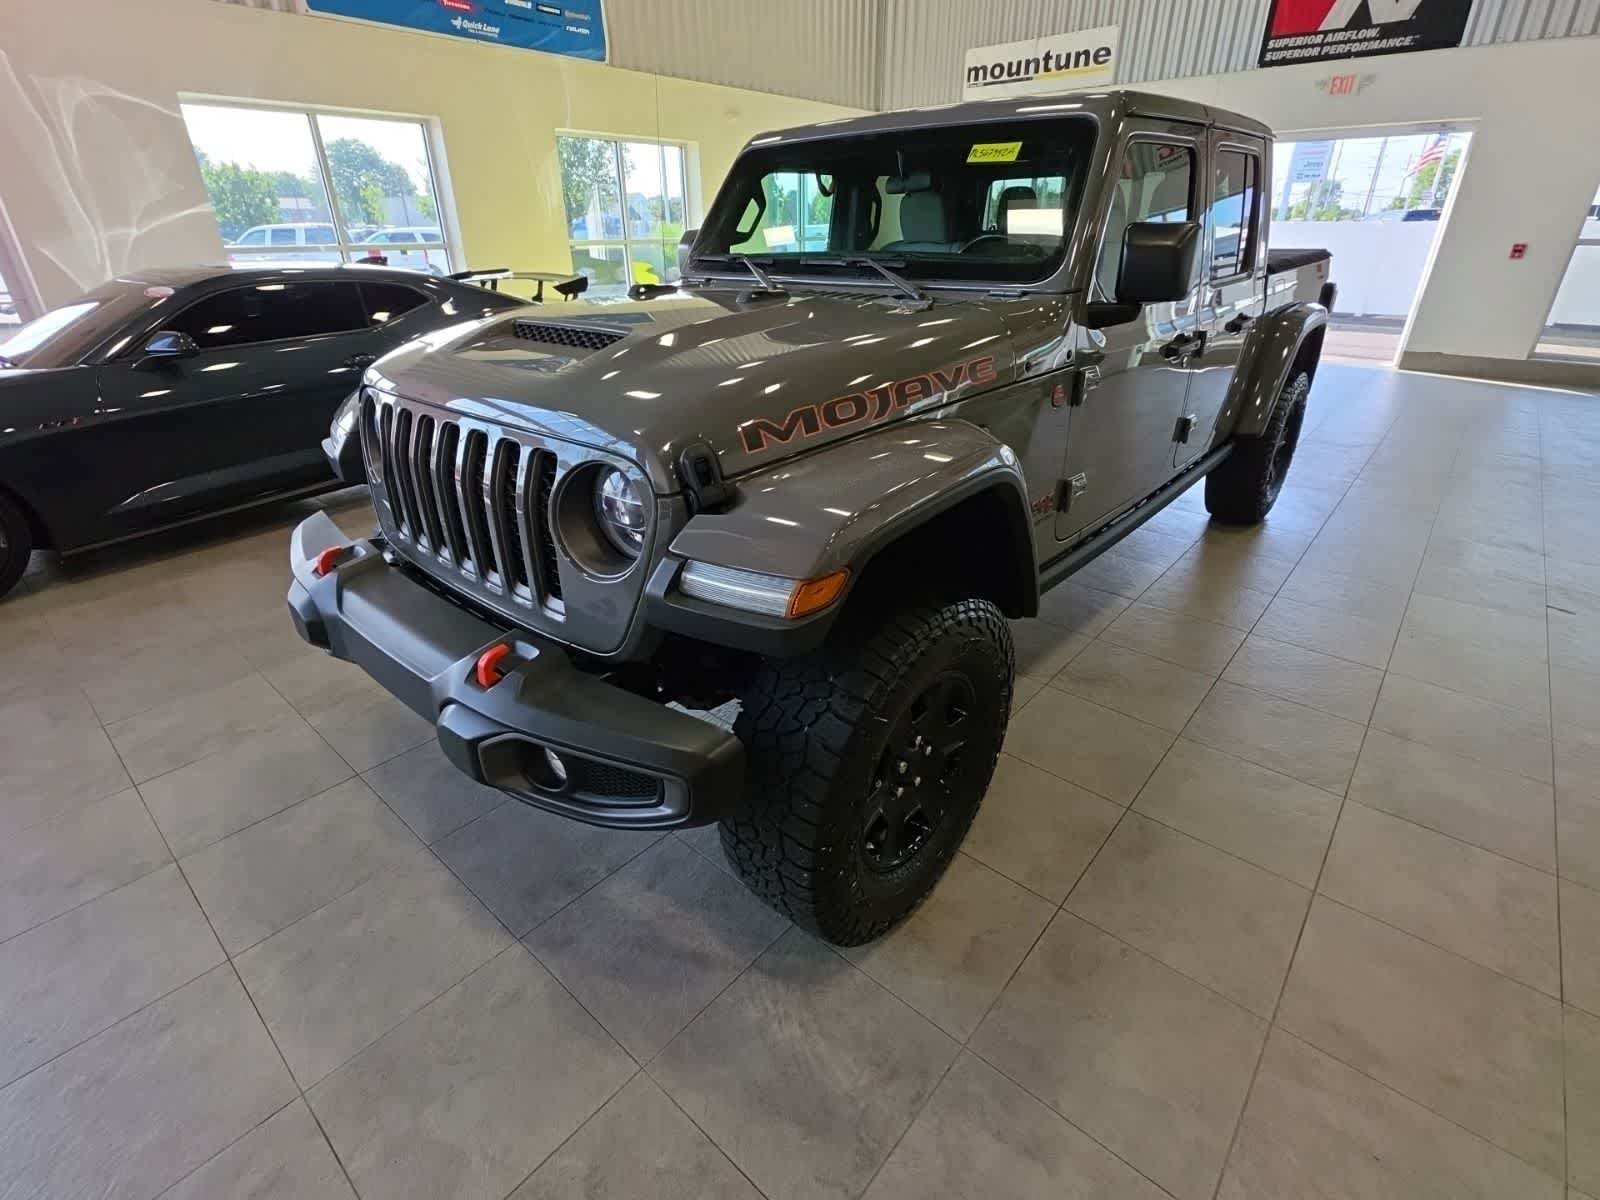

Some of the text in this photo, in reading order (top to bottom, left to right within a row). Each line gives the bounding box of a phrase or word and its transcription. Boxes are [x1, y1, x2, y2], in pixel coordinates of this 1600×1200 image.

[462, 19, 483, 31] Quick
[483, 23, 500, 34] Lane
[1267, 27, 1380, 49] SUPERIOR AIRFLOW.
[1264, 46, 1322, 61] SUPERIOR
[967, 46, 1111, 83] mountune
[1329, 75, 1355, 95] EXIT
[739, 357, 998, 454] MOJAVE
